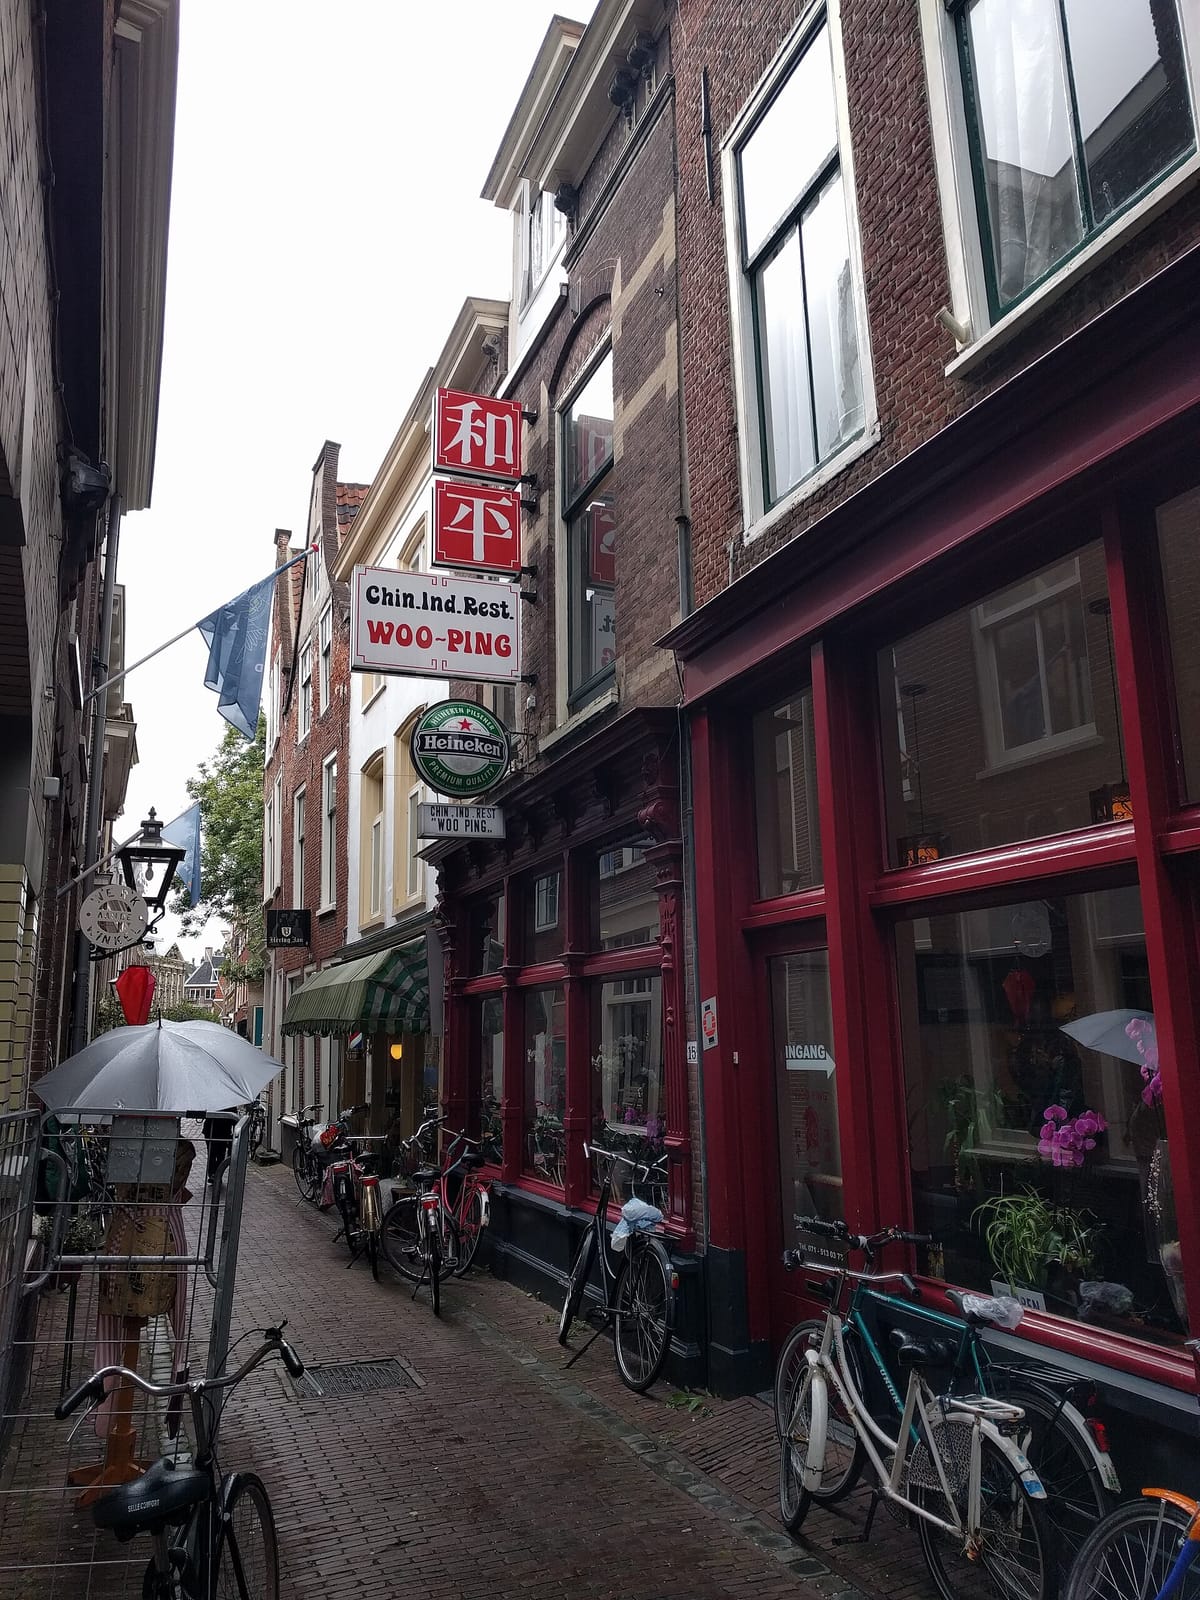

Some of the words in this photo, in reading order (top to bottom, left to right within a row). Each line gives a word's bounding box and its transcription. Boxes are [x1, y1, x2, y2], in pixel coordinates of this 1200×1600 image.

[444, 400, 513, 466] 和
[442, 492, 512, 561] 平
[430, 706, 464, 726] HEINEKEN
[466, 706, 495, 731] PILSENER
[423, 735, 501, 757] Heineken
[428, 760, 463, 786] PREMIUM
[465, 766, 496, 786] QUALITY
[785, 1044, 826, 1060] INGANG
[879, 1368, 901, 1405] UNION
